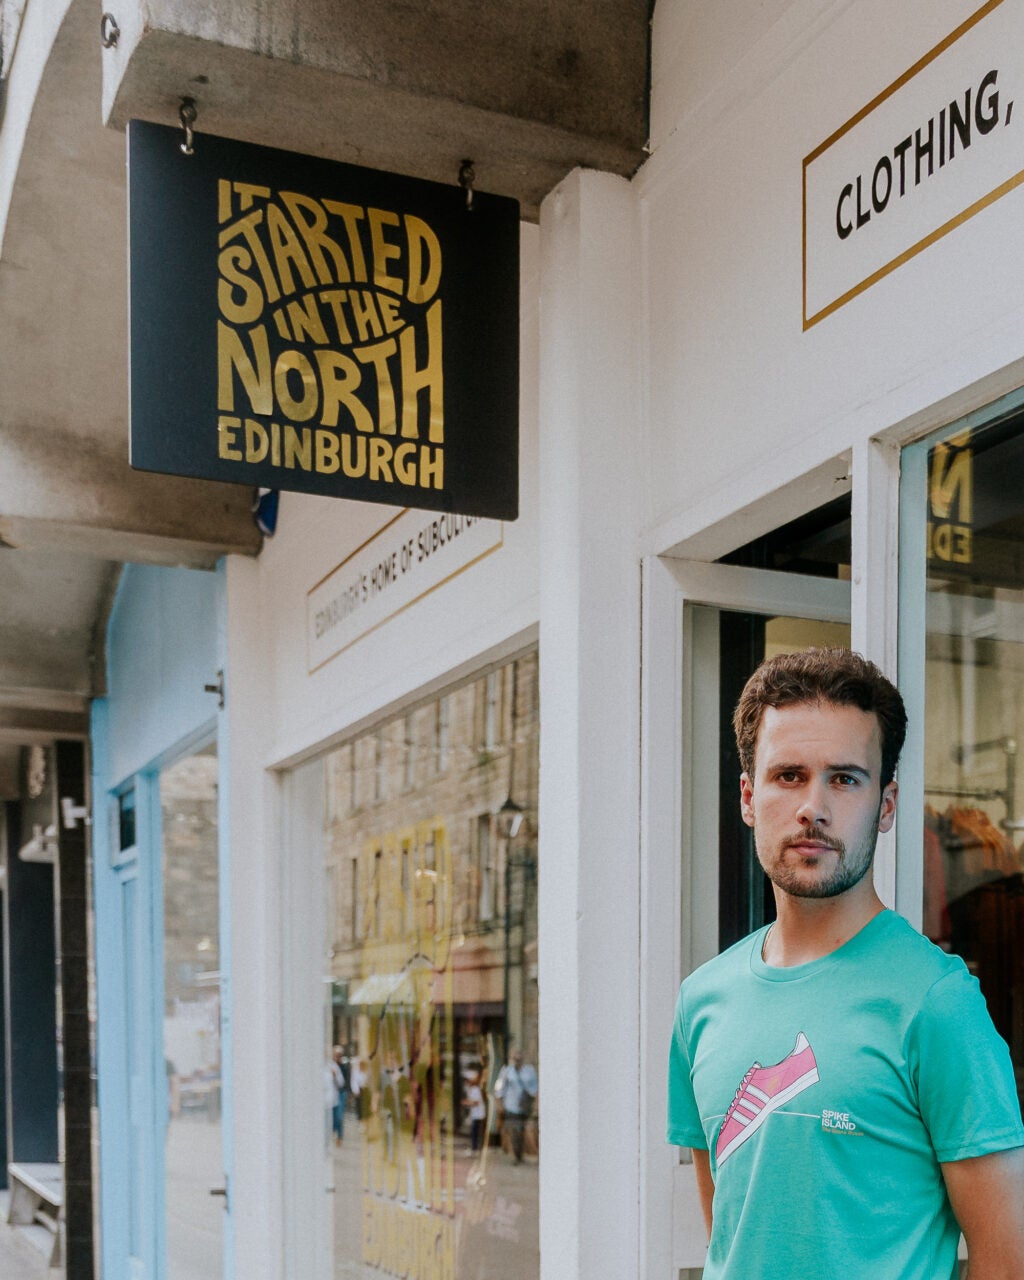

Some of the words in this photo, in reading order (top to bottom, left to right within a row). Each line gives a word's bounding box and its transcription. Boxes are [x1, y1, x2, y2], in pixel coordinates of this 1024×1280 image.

[836, 69, 1014, 240] CLOTHING,
[218, 178, 271, 224] IT
[218, 191, 442, 324] STARTED
[273, 293, 329, 344] IN
[320, 289, 406, 345] THE
[218, 299, 444, 443] NORTH
[218, 415, 444, 490] EDINBURGH
[371, 551, 397, 595] HOME
[822, 1109, 850, 1122] SPIKE
[822, 1118, 856, 1131] ISLAND
